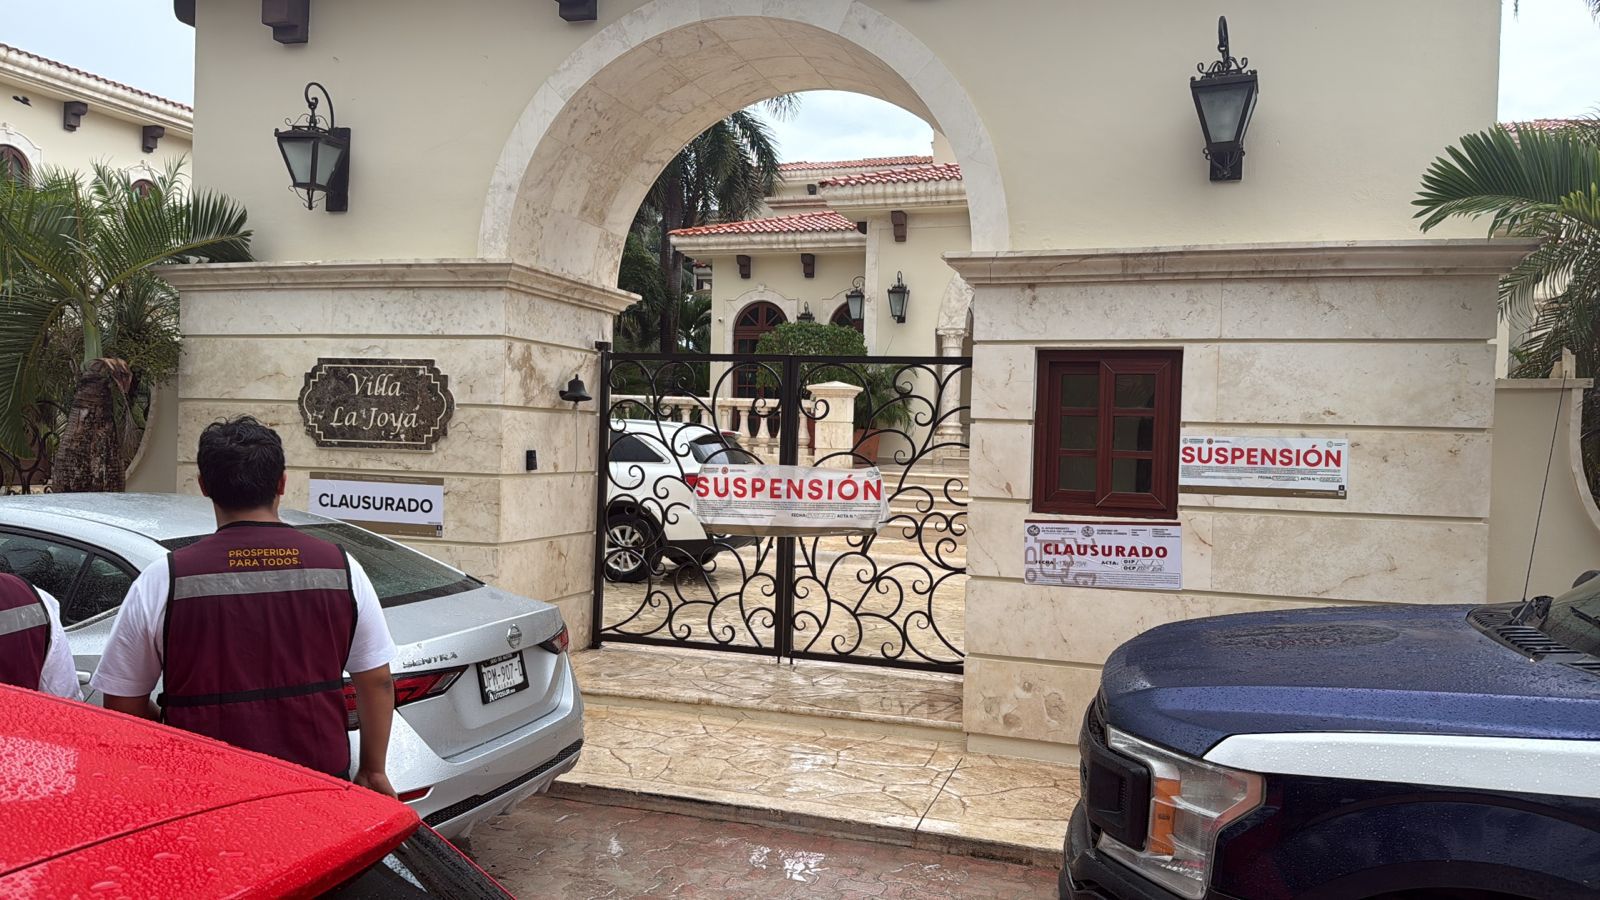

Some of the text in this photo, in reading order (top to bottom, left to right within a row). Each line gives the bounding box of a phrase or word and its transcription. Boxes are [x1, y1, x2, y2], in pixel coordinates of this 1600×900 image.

[346, 373, 402, 396] Villa
[330, 406, 358, 426] La
[1181, 444, 1342, 468] SUSPENSIÓN
[695, 474, 882, 501] SUSPENSIÓN
[318, 492, 434, 514] CLAUSURADO
[228, 548, 300, 557] PROSPERIDAD
[1043, 543, 1168, 559] CLAUSURADO
[229, 557, 302, 567] PARA TODOS.
[402, 652, 458, 668] SENTRA
